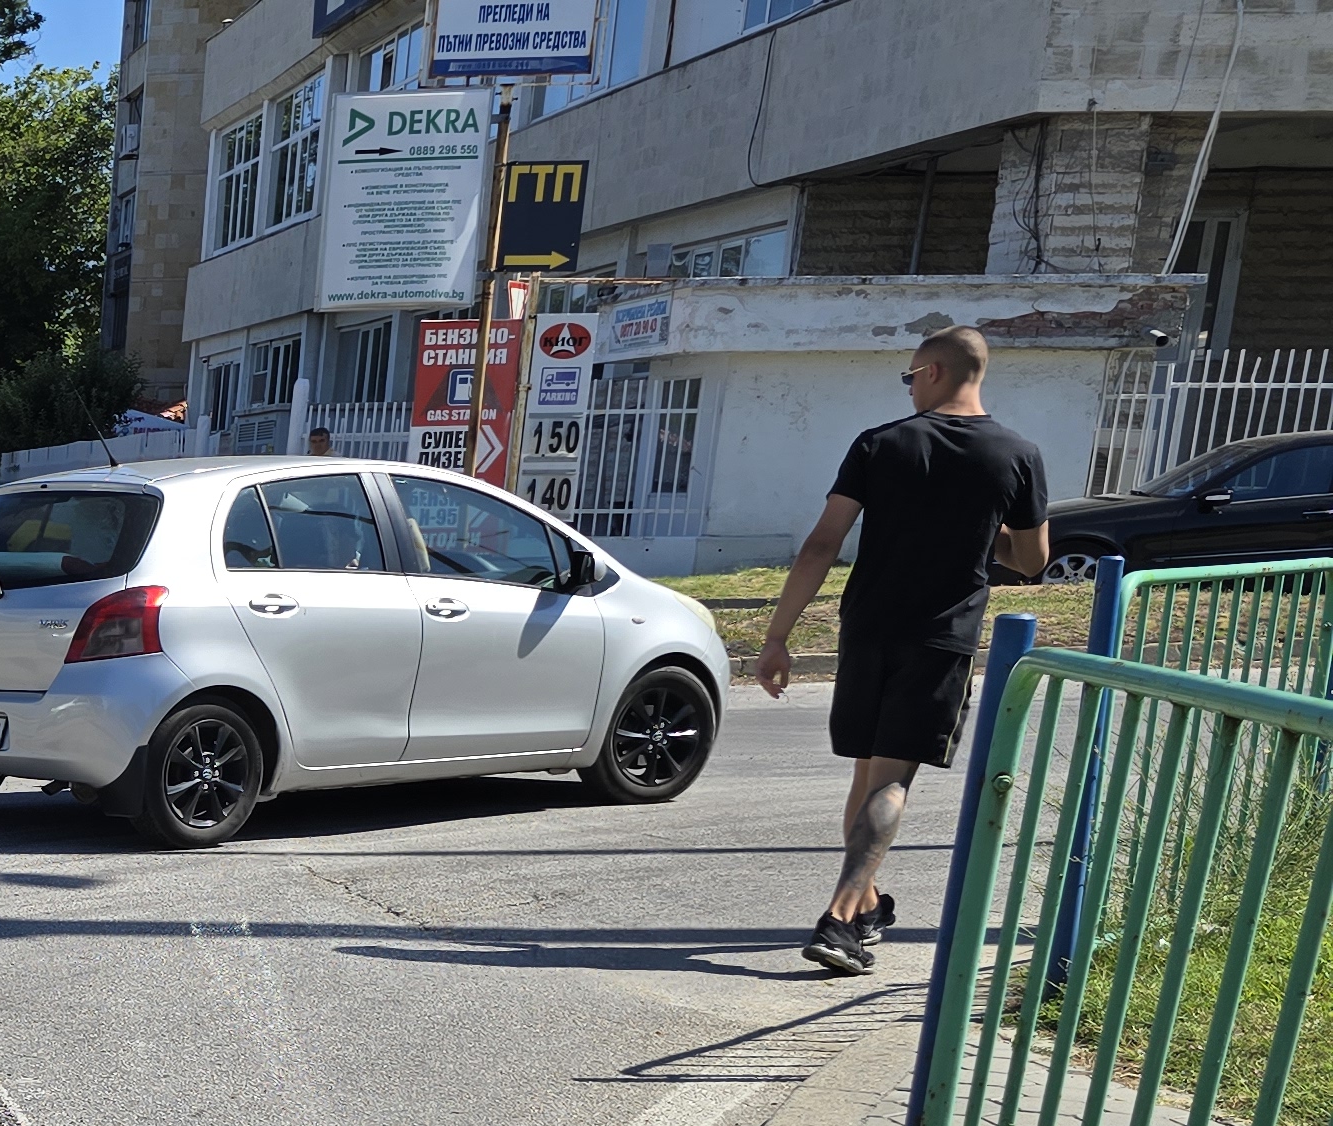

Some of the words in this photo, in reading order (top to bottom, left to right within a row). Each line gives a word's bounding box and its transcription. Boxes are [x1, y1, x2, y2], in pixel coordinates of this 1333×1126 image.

[478, 3, 533, 24] ПРЕГЛЕДИ
[536, 3, 550, 21] НА
[438, 34, 473, 53] ПЪТНИ
[474, 32, 530, 52] ПРЕВОЗНИ
[533, 30, 587, 51] СРЕДСТВА
[387, 107, 480, 136] DEKRA
[409, 146, 435, 156] 0889
[438, 145, 457, 155] 296
[460, 144, 478, 154] 550
[507, 164, 583, 202] ГТП
[328, 288, 465, 302] www.dekra-automotive.bg
[540, 391, 576, 402] PARKING
[427, 410, 451, 421] GAS
[451, 409, 497, 421] STAON
[418, 451, 464, 468] ДИЗЕ
